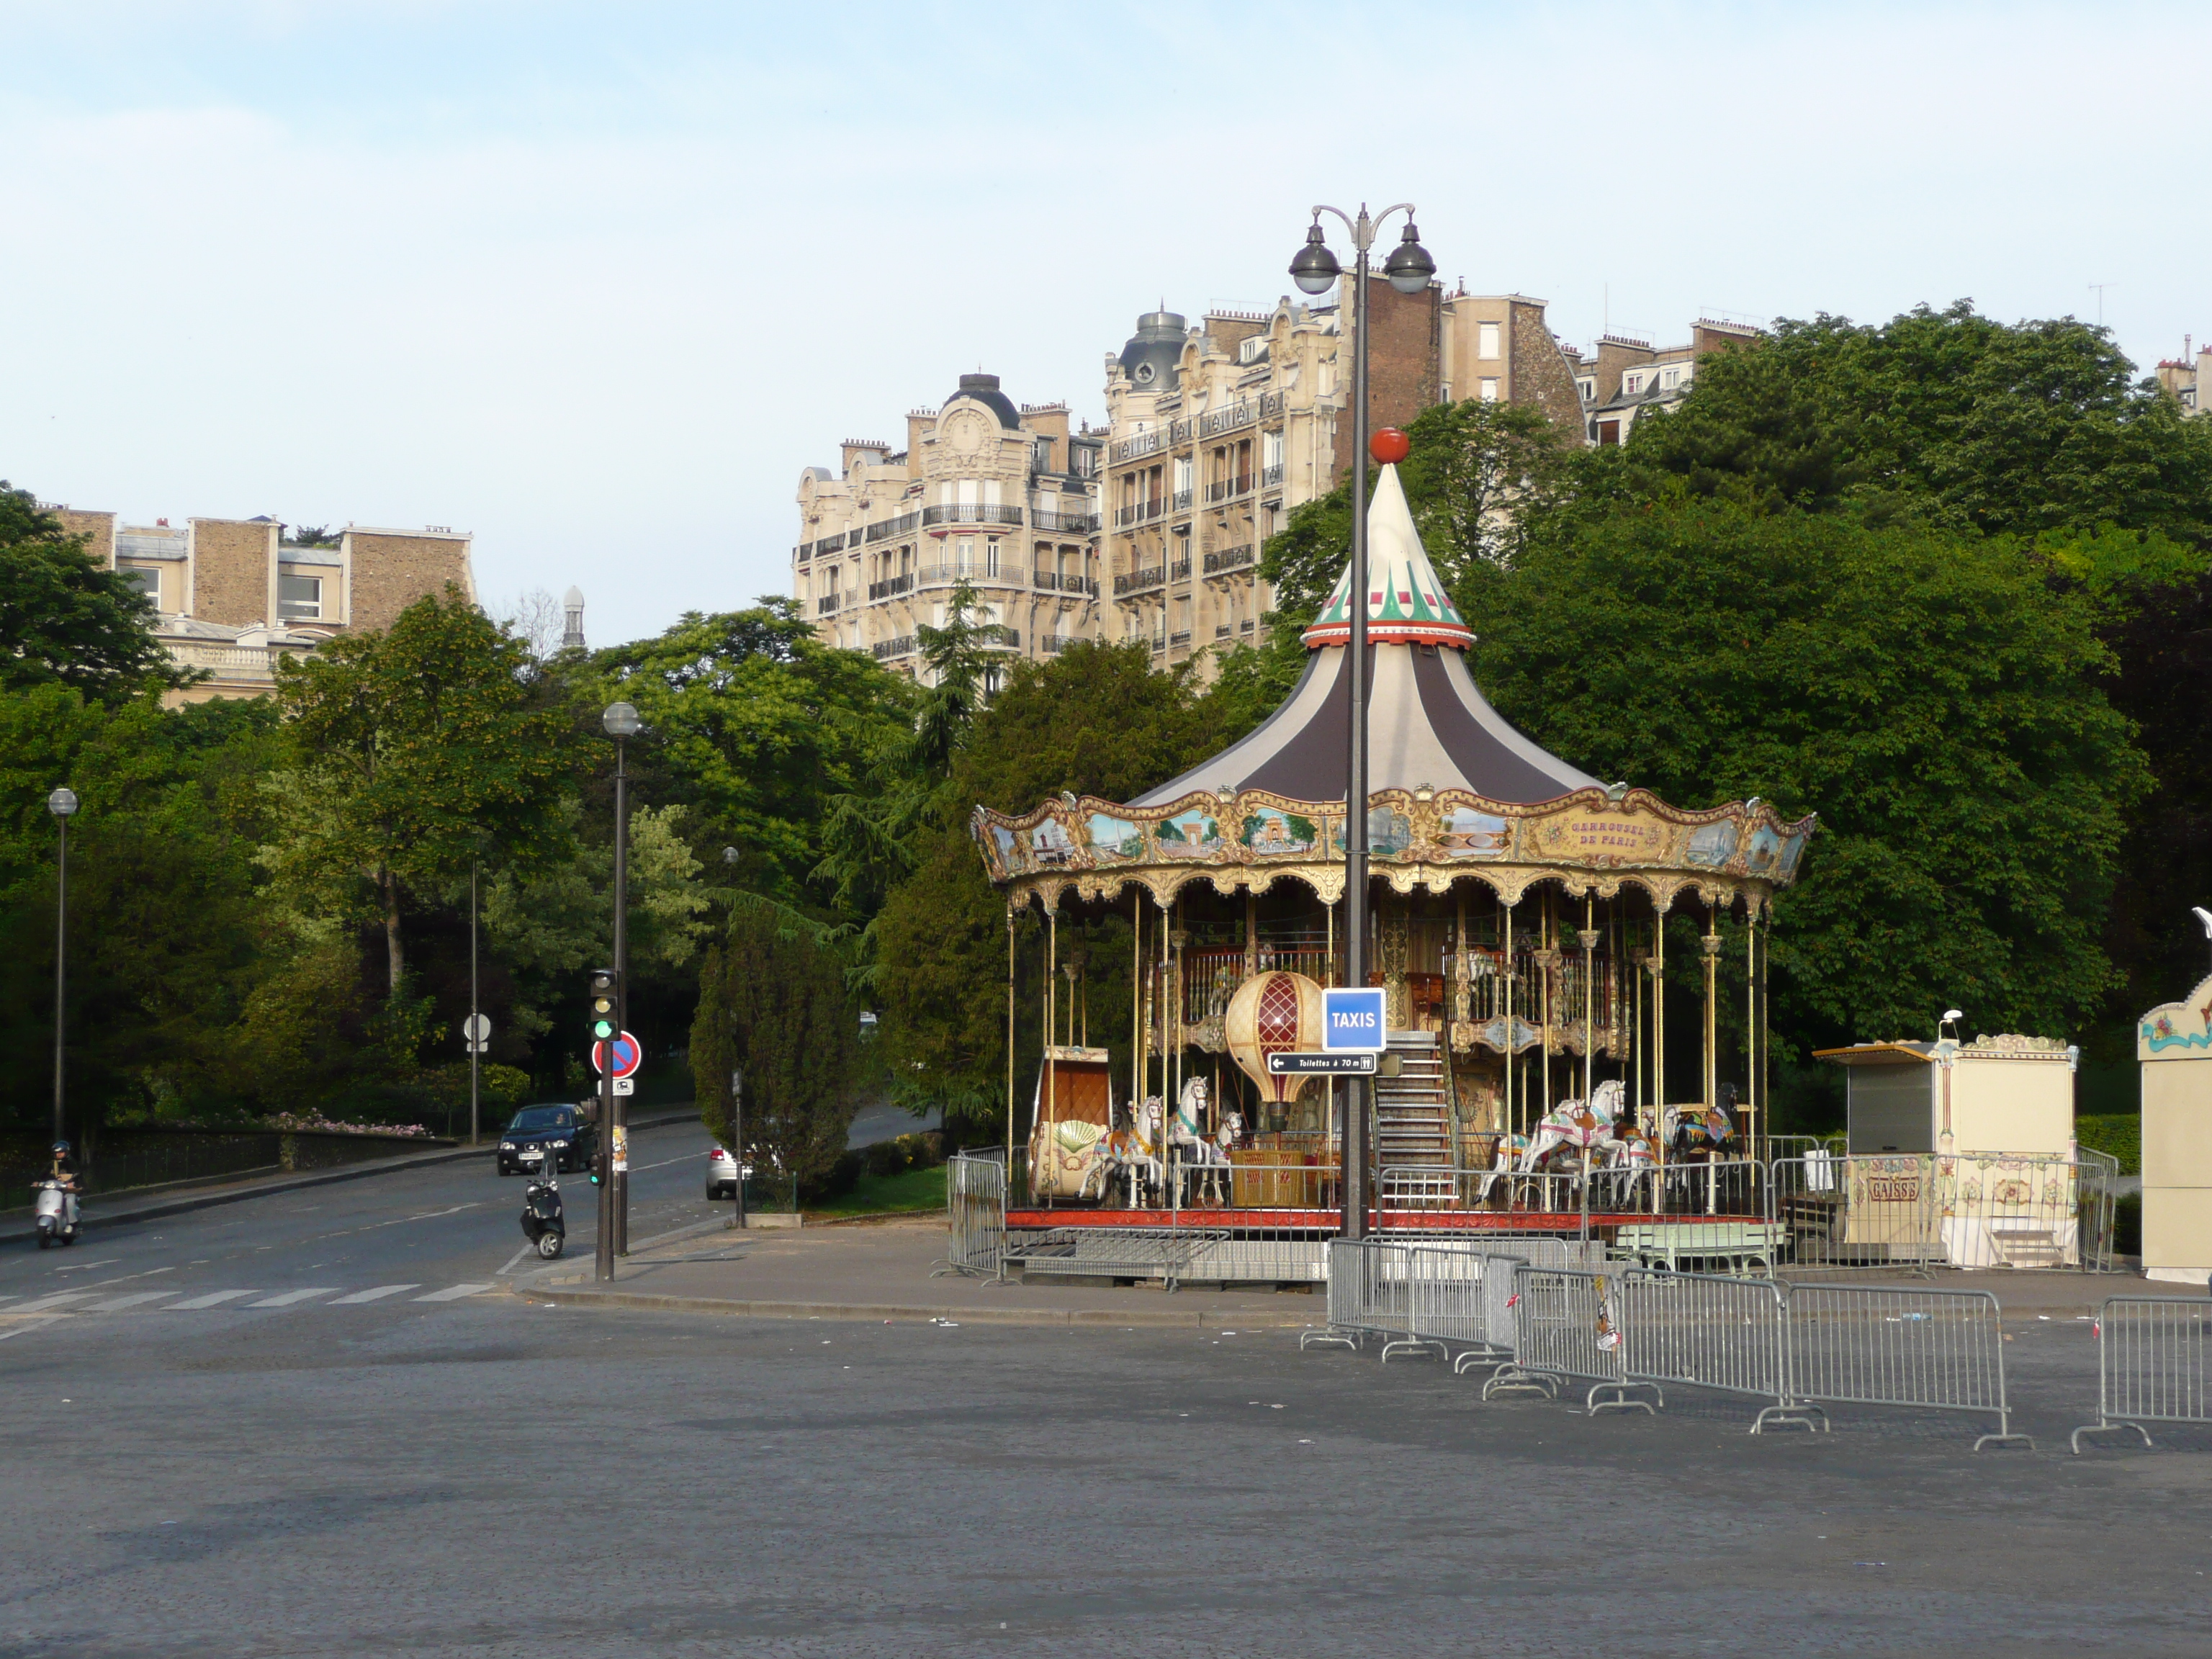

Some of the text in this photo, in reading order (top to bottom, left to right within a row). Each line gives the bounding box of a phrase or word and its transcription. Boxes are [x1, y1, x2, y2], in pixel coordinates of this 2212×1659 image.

[1572, 822, 1644, 835] CARROUSEL
[1580, 835, 1637, 848] DE PARIS
[1332, 1012, 1375, 1028] TAXIS
[1874, 1182, 1915, 1197] CAISSE
